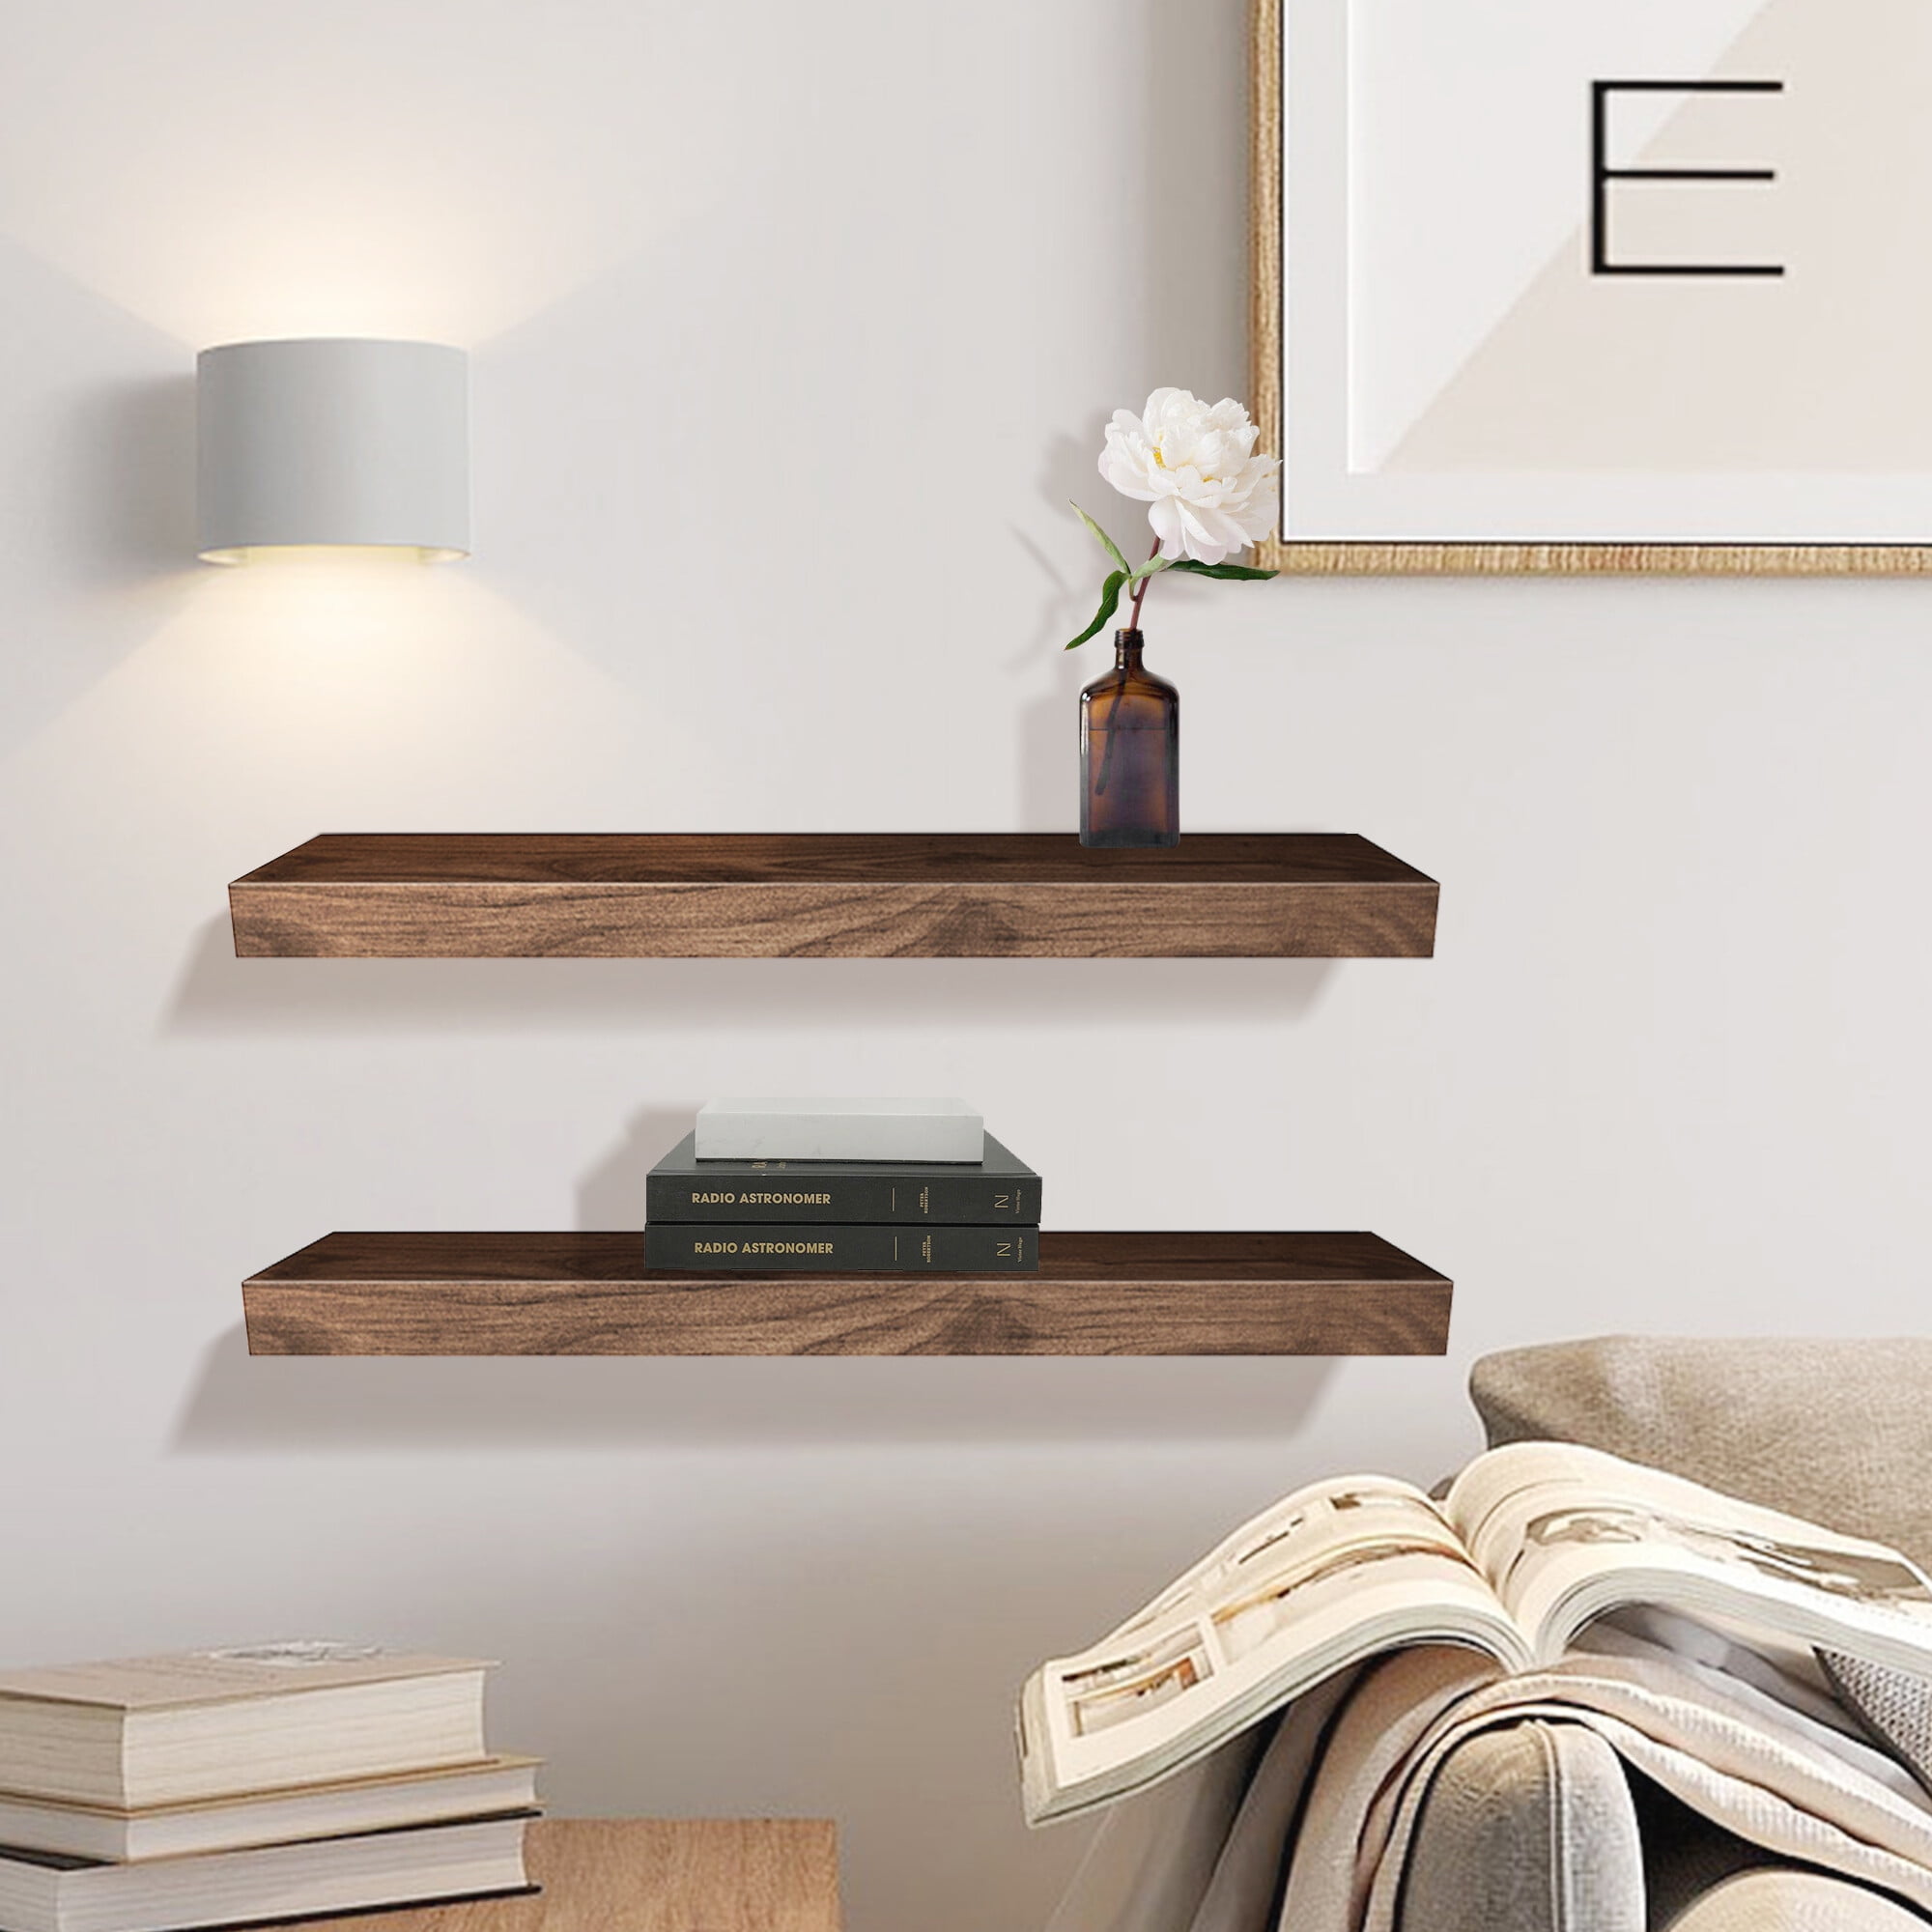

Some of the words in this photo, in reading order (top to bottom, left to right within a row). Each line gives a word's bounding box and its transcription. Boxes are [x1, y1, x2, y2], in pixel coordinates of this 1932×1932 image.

[1591, 80, 1785, 276] E
[691, 1192, 736, 1206] RADIO
[738, 1192, 831, 1206] ASTRONOMER
[694, 1241, 739, 1255] RADIO
[741, 1241, 834, 1255] ASTRONOMER
